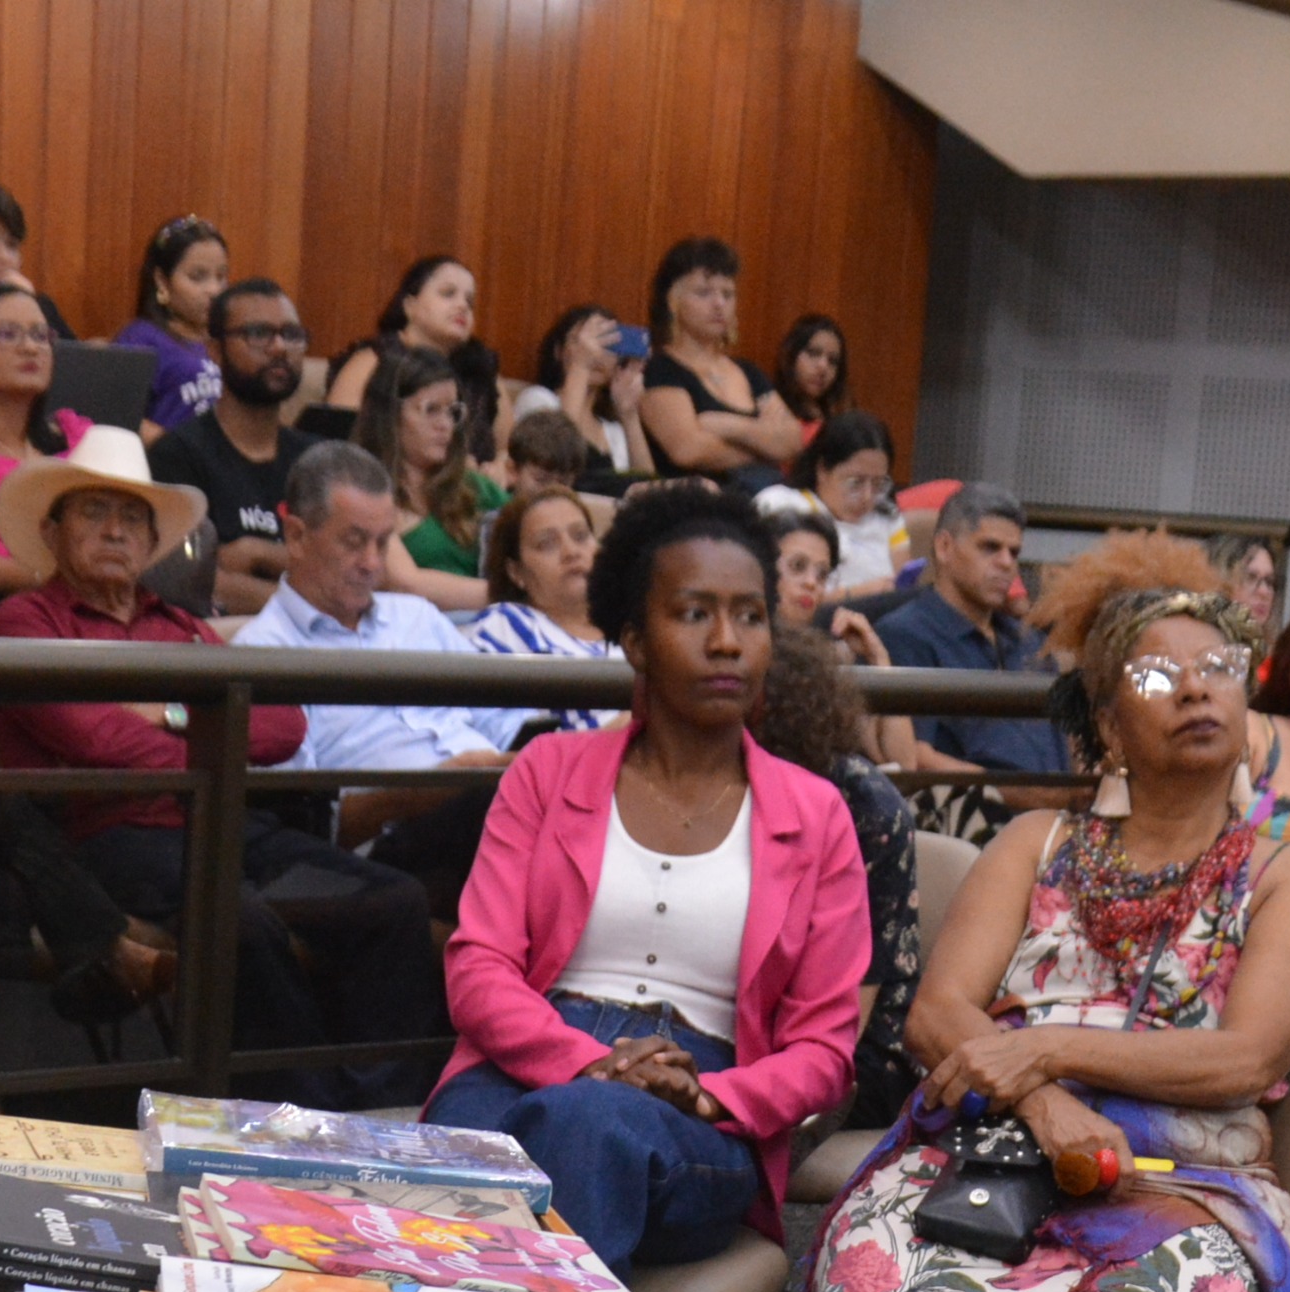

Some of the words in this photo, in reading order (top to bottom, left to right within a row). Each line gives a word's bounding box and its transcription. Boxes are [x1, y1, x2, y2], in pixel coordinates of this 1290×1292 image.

[9, 1247, 49, 1263] Coração
[50, 1253, 84, 1268] líquido
[86, 1261, 100, 1270] em
[102, 1262, 136, 1276] chamas
[4, 1265, 43, 1281] Coração
[44, 1271, 78, 1286] líquido
[80, 1280, 94, 1289] em
